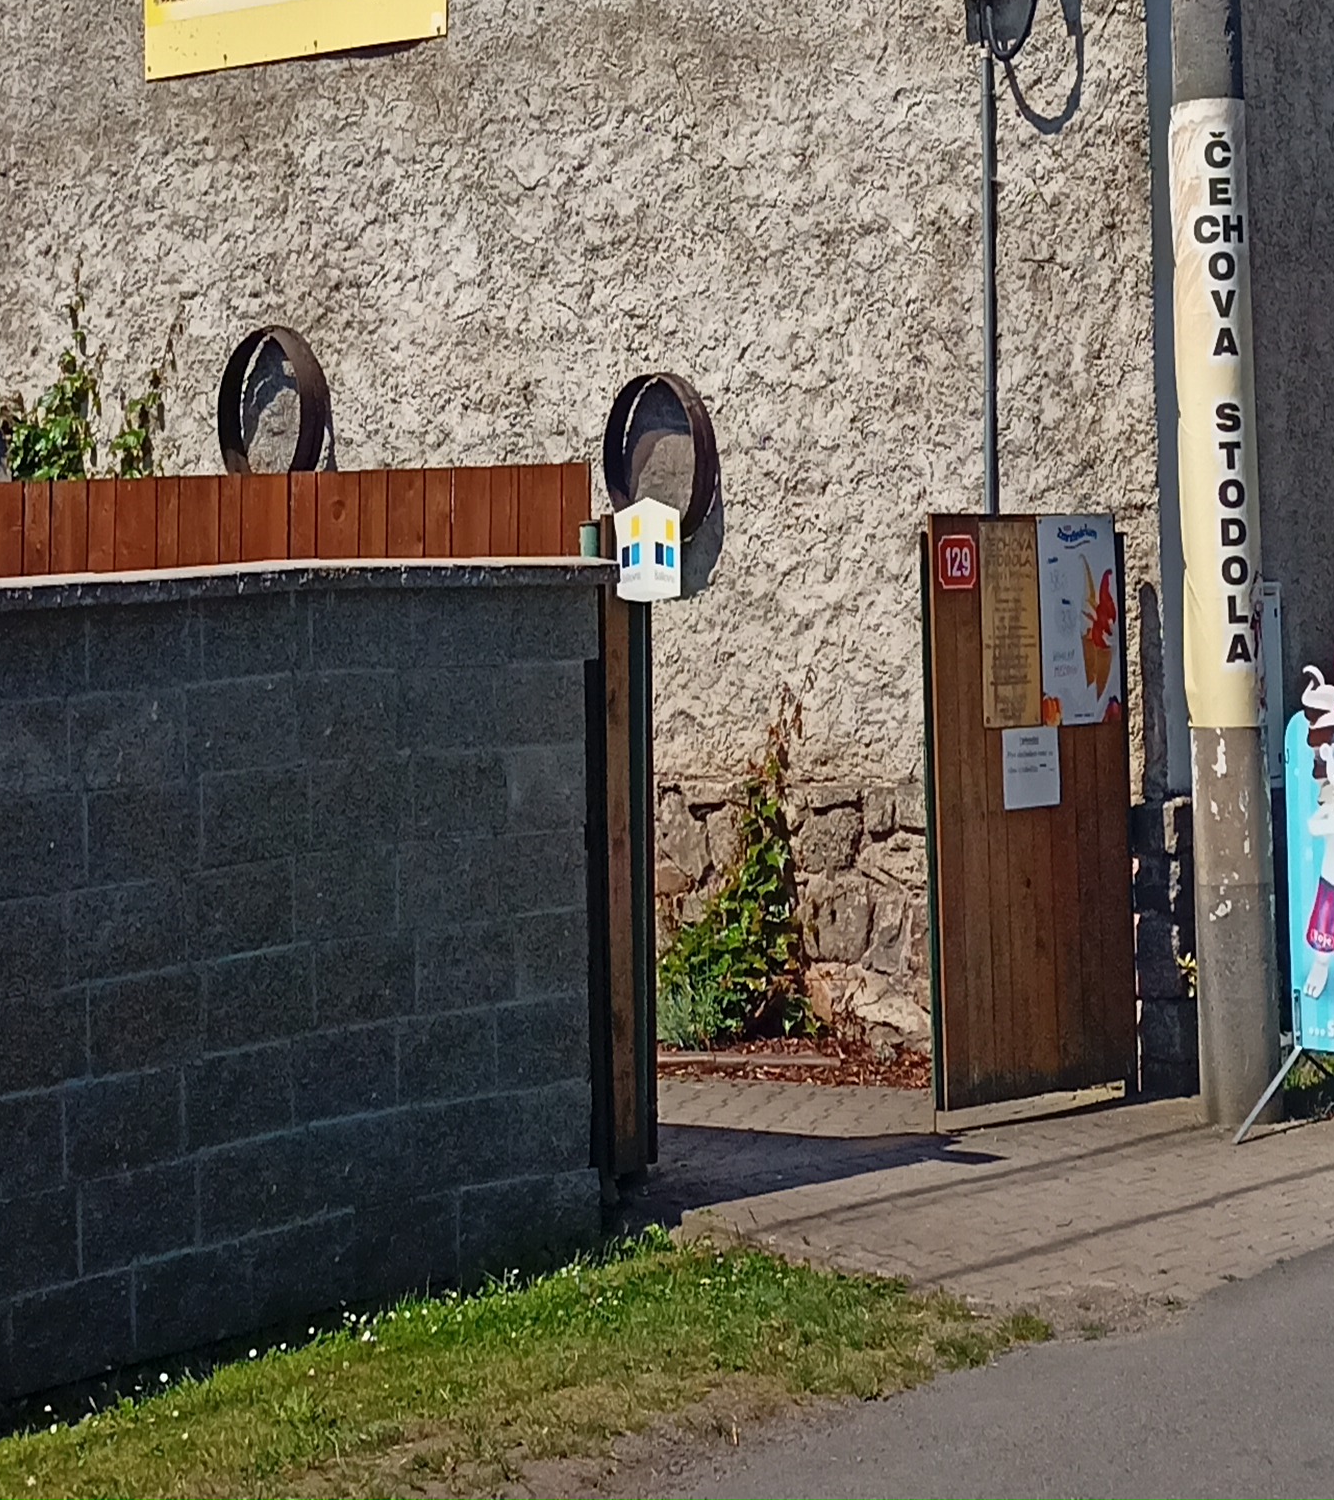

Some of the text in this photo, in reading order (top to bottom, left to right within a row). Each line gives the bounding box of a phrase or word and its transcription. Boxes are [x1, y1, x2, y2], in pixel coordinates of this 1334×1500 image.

[1193, 131, 1252, 663] ČECHOVA STODOLA
[946, 547, 971, 577] 129
